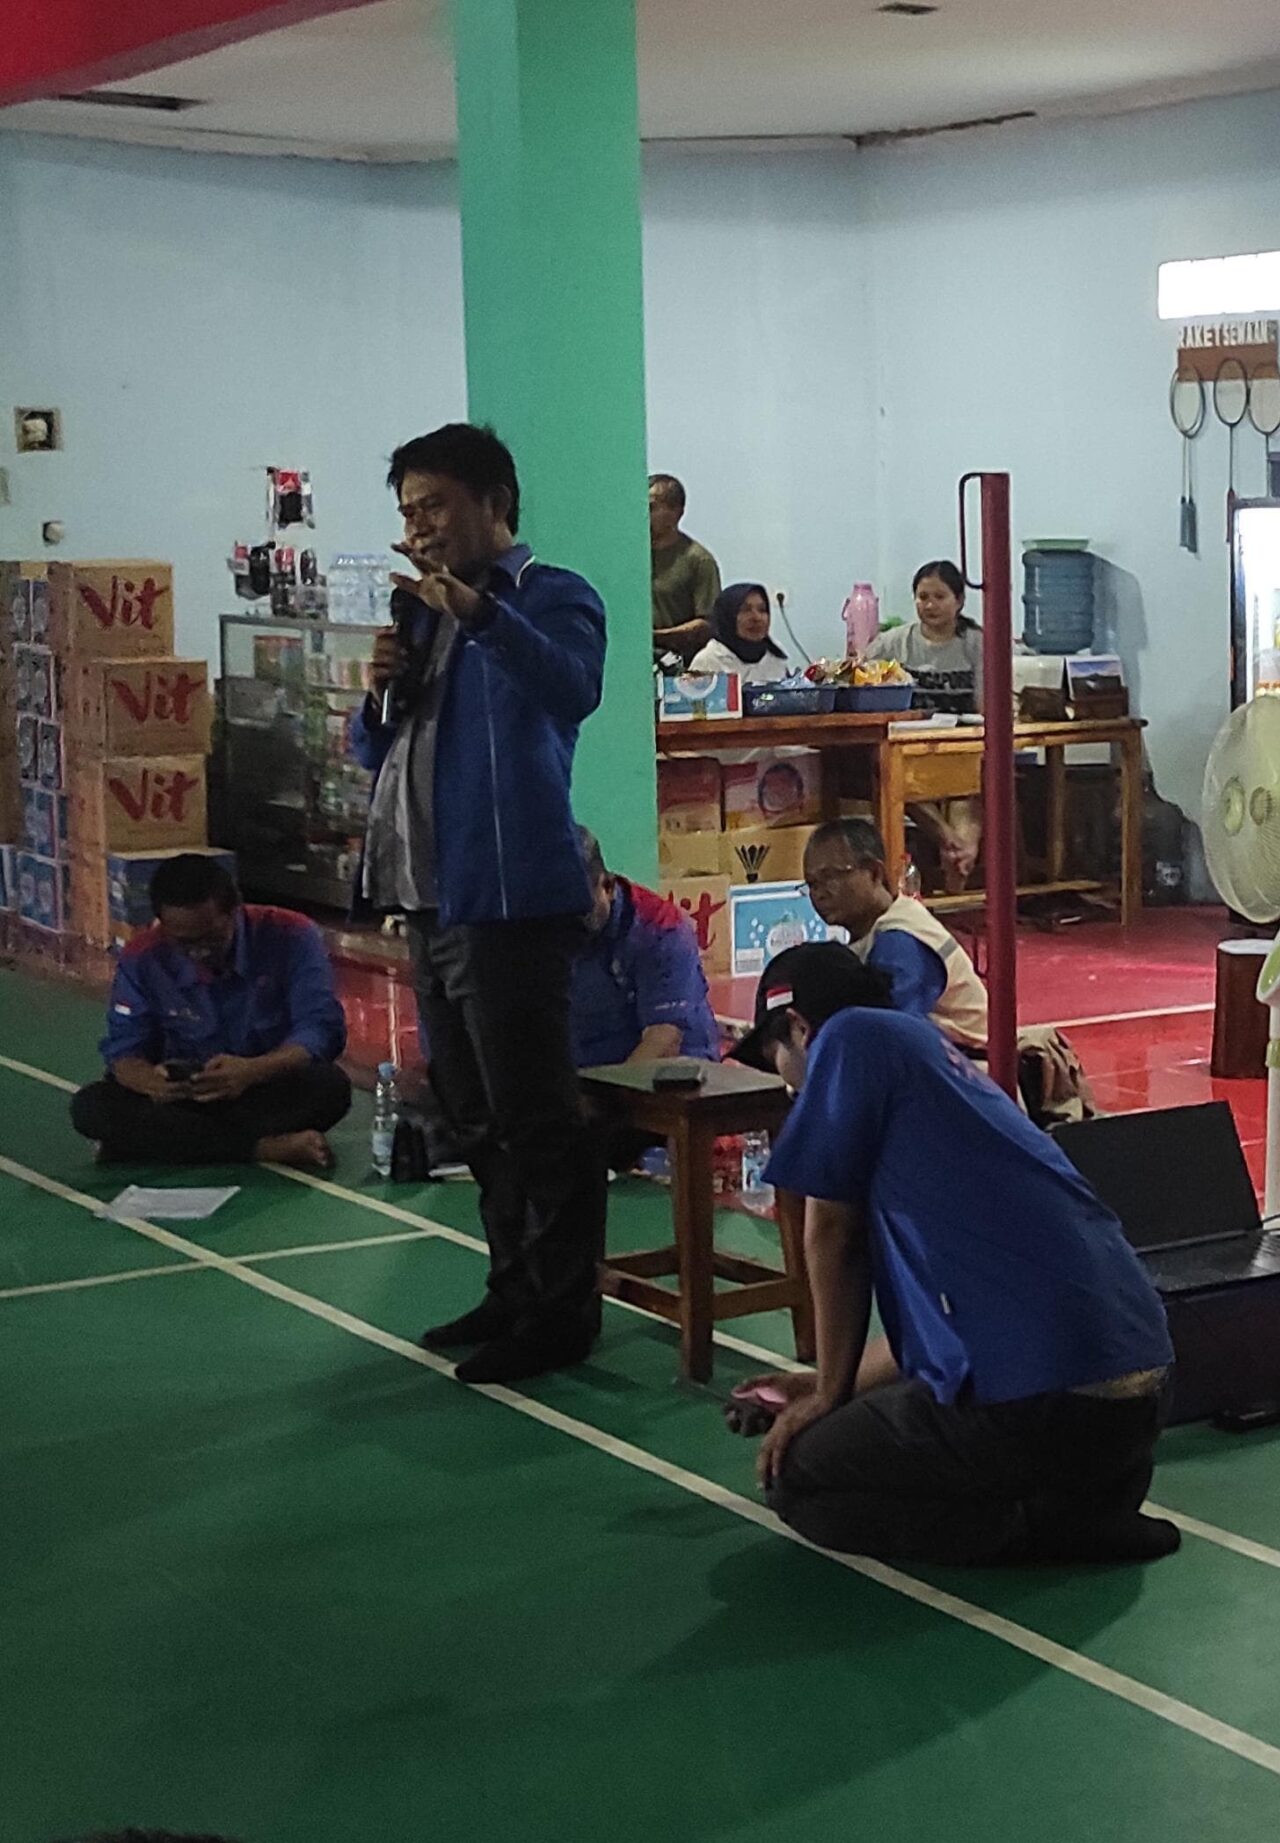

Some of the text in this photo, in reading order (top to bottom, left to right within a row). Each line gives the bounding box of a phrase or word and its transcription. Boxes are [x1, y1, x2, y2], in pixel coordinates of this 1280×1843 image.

[79, 575, 169, 630] Vit
[110, 672, 206, 725] Vit
[107, 768, 199, 822] Vit
